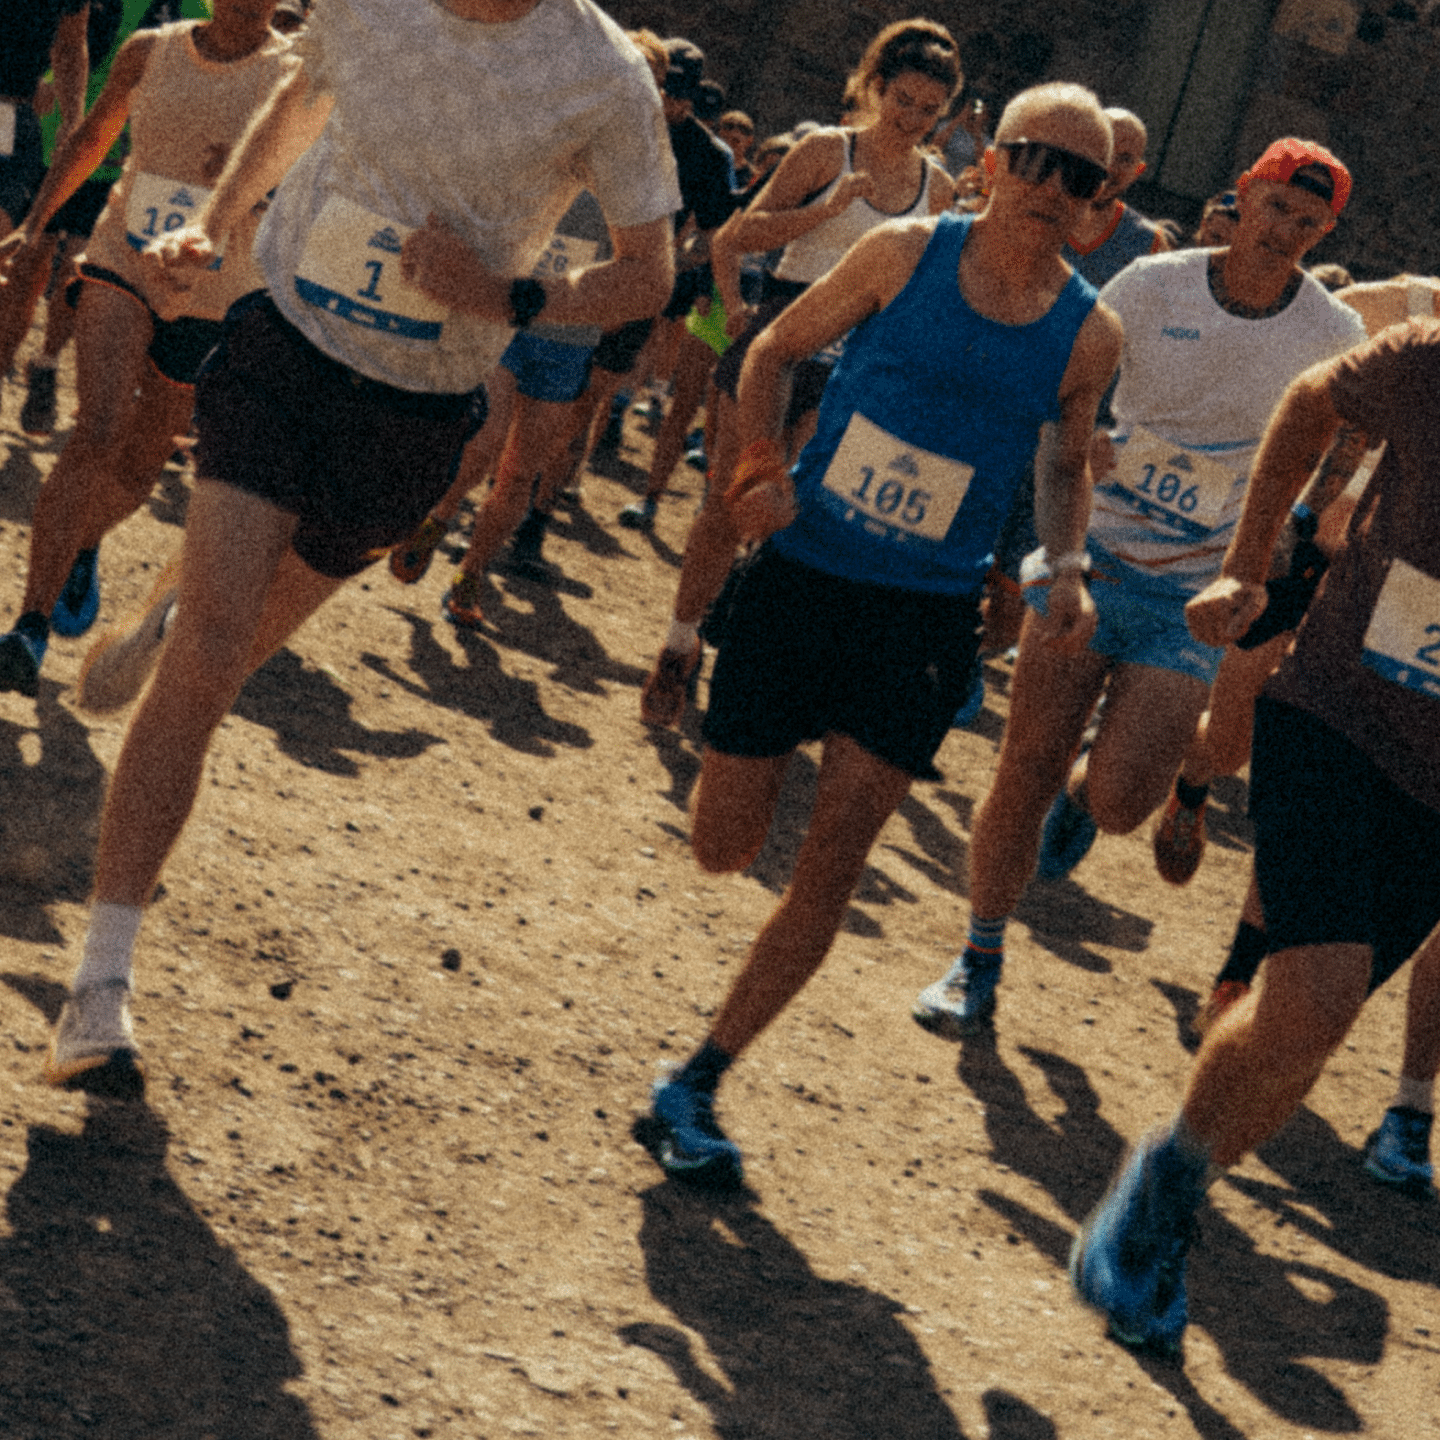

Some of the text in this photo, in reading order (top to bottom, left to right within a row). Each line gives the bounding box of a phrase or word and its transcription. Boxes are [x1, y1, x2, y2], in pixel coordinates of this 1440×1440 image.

[357, 260, 383, 302] 1
[851, 465, 932, 525] 105
[1136, 463, 1200, 513] 106
